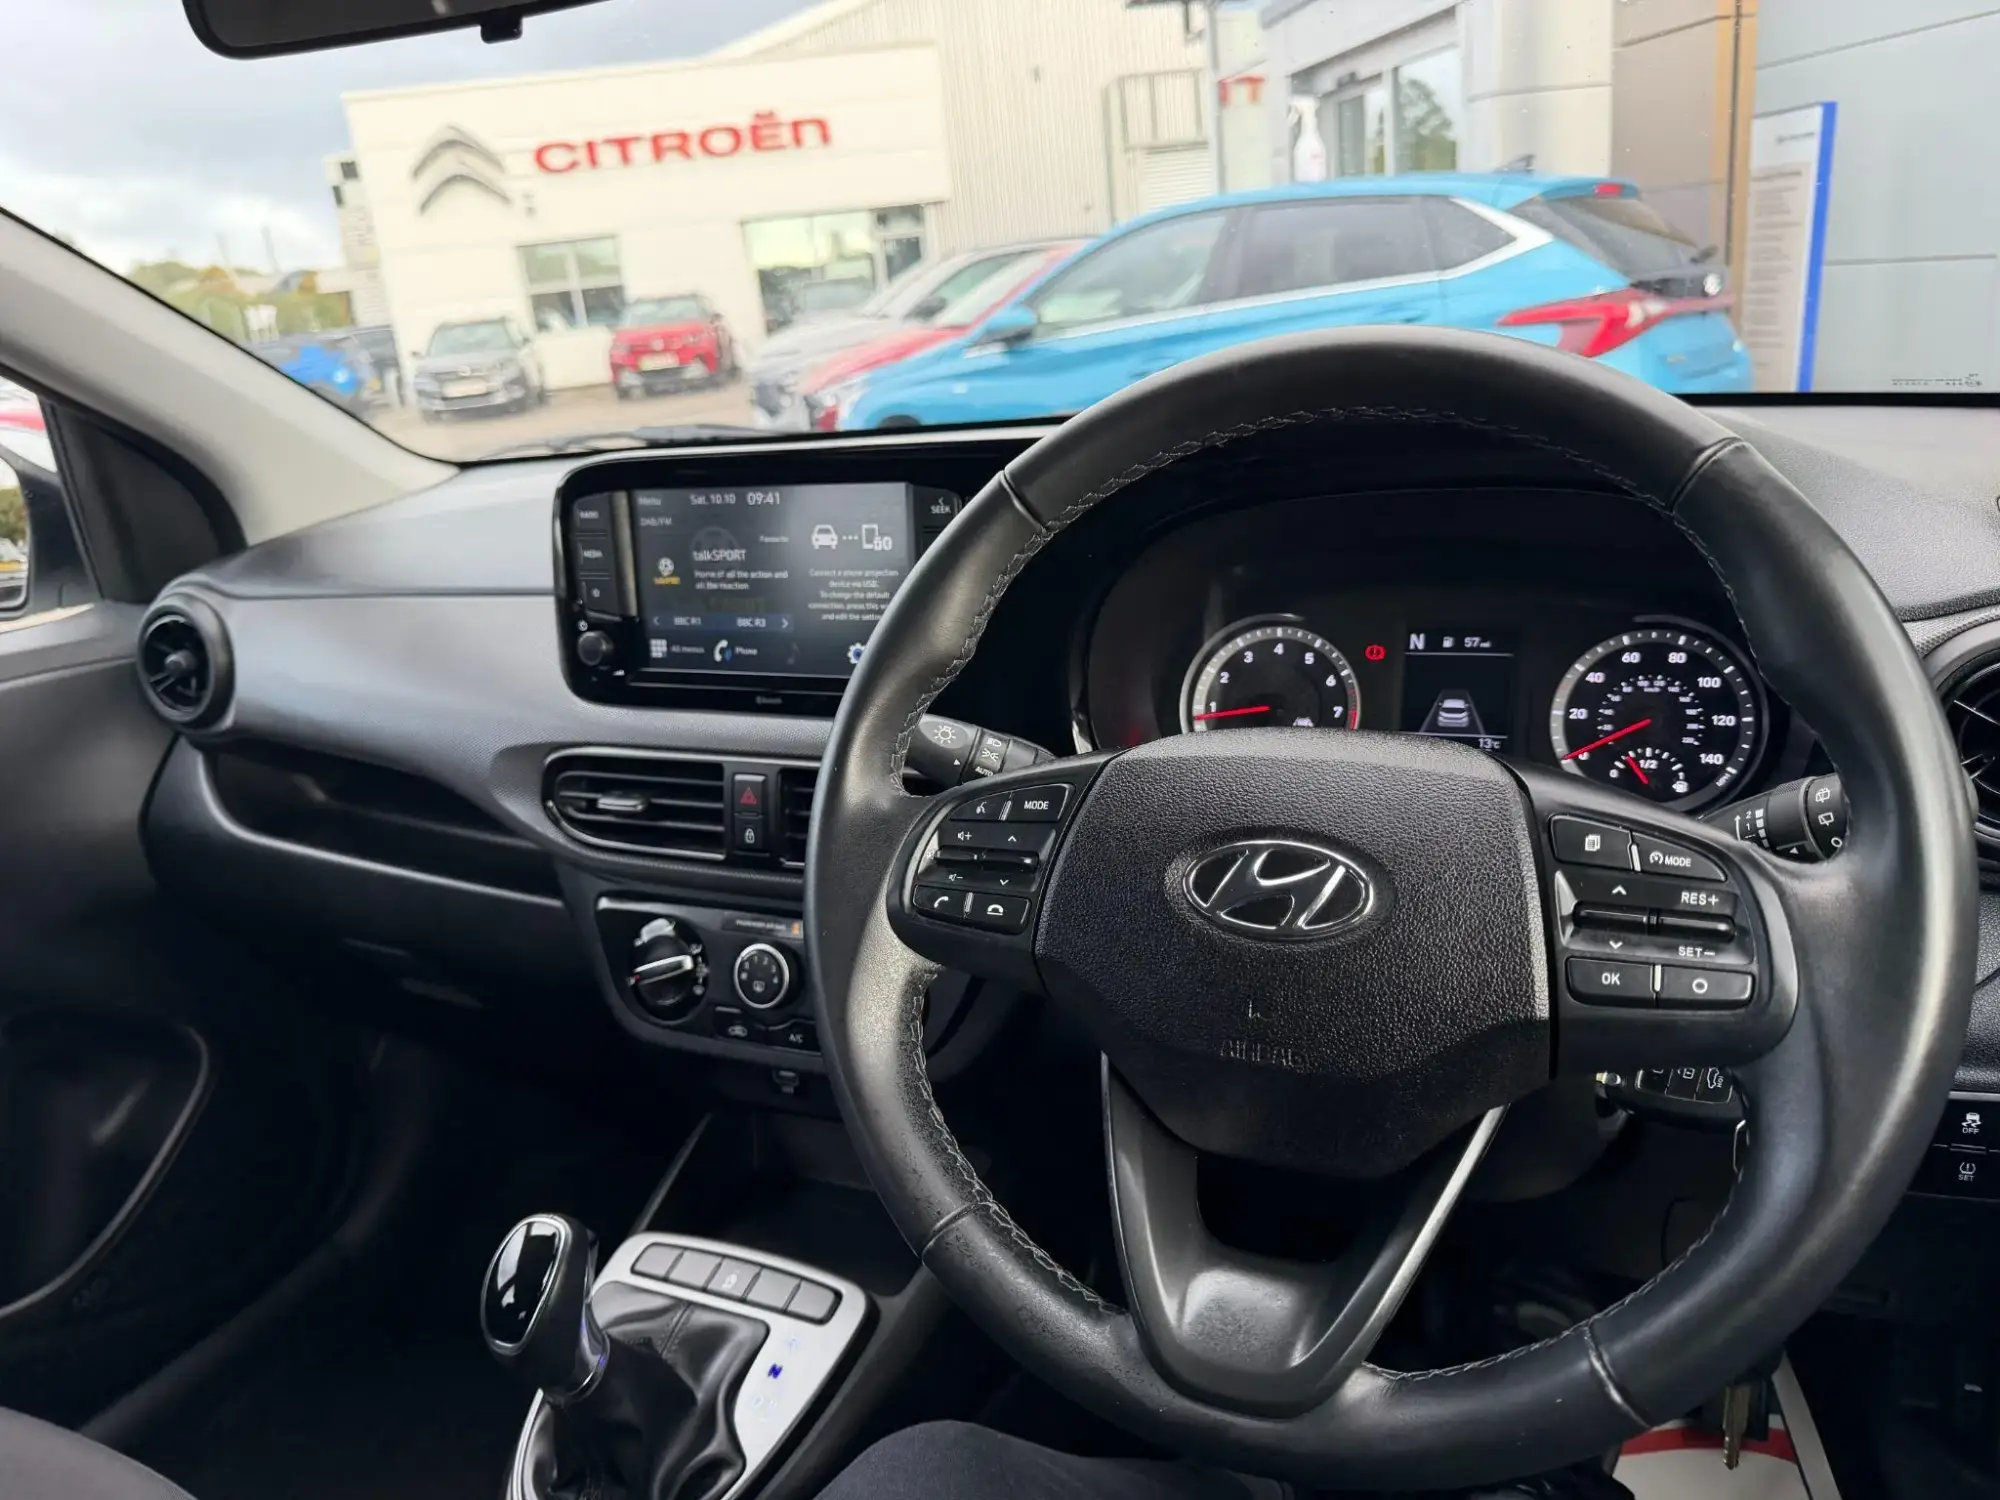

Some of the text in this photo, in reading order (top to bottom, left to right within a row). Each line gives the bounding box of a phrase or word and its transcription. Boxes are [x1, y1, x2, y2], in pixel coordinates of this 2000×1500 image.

[746, 491, 780, 506] 09:41
[930, 505, 951, 514] SEEK
[692, 549, 747, 562] talkSPORT
[774, 570, 789, 579] and
[1409, 632, 1426, 650] N
[735, 647, 758, 656] Phone
[1273, 642, 1285, 656] 4
[1243, 650, 1254, 664] 3
[1304, 651, 1315, 665] 5
[1621, 651, 1641, 663] 60
[1667, 651, 1688, 664] 80
[1219, 671, 1230, 684] 2
[1325, 674, 1337, 688] 6
[1585, 671, 1606, 684] 40
[1697, 676, 1721, 689] 100
[1209, 701, 1217, 713] 1
[1333, 706, 1344, 719] 7
[1568, 707, 1588, 720] 20
[1711, 714, 1736, 727] 120
[1639, 759, 1659, 770] 1/2
[1699, 752, 1724, 766] 140
[975, 766, 994, 777] AUTO
[1609, 769, 1620, 779] 0
[1024, 800, 1049, 810] MODE
[1745, 811, 1752, 820] 2
[1664, 855, 1692, 868] MODE
[1601, 972, 1621, 986] OK
[1958, 1173, 1975, 1182] SET
